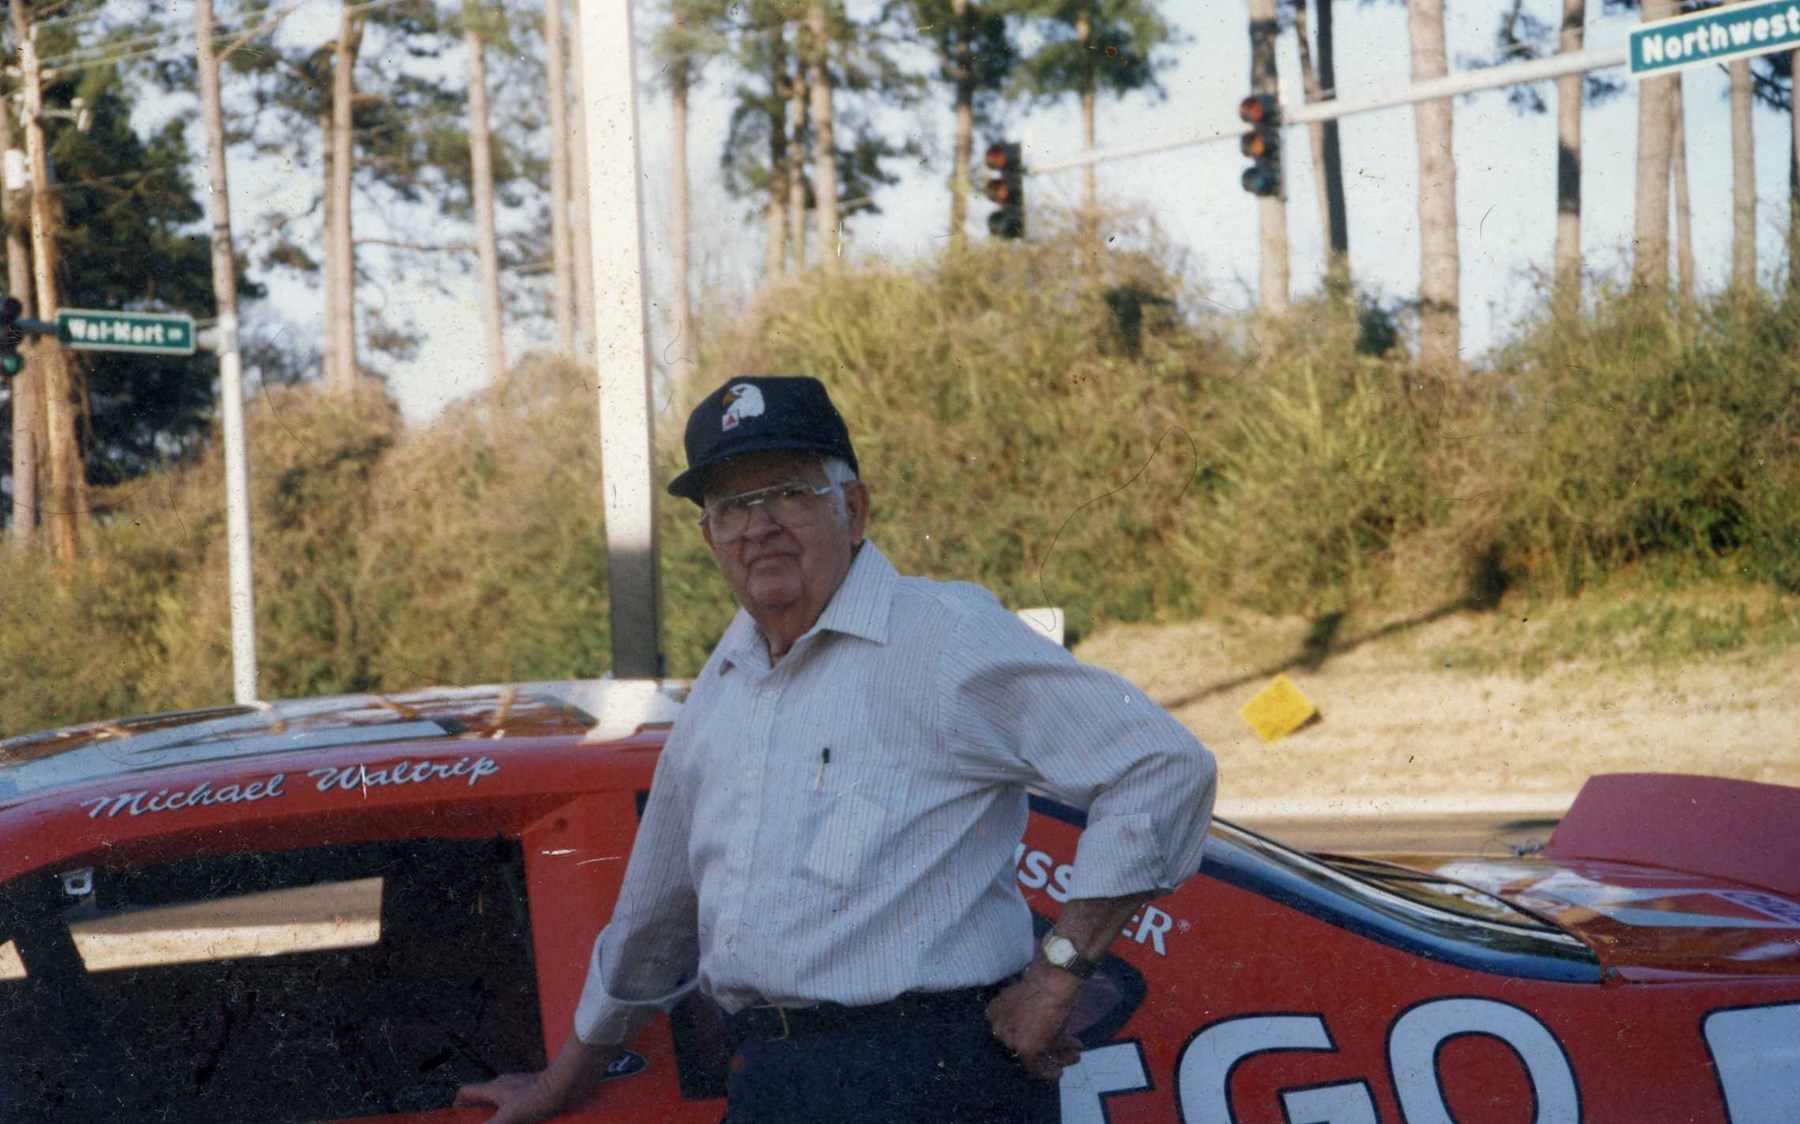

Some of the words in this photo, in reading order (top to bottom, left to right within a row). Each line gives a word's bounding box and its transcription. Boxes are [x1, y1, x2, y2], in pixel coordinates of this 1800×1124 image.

[1641, 5, 1800, 64] Northwest
[80, 773, 285, 819] Michael
[307, 756, 499, 792] Waltrip
